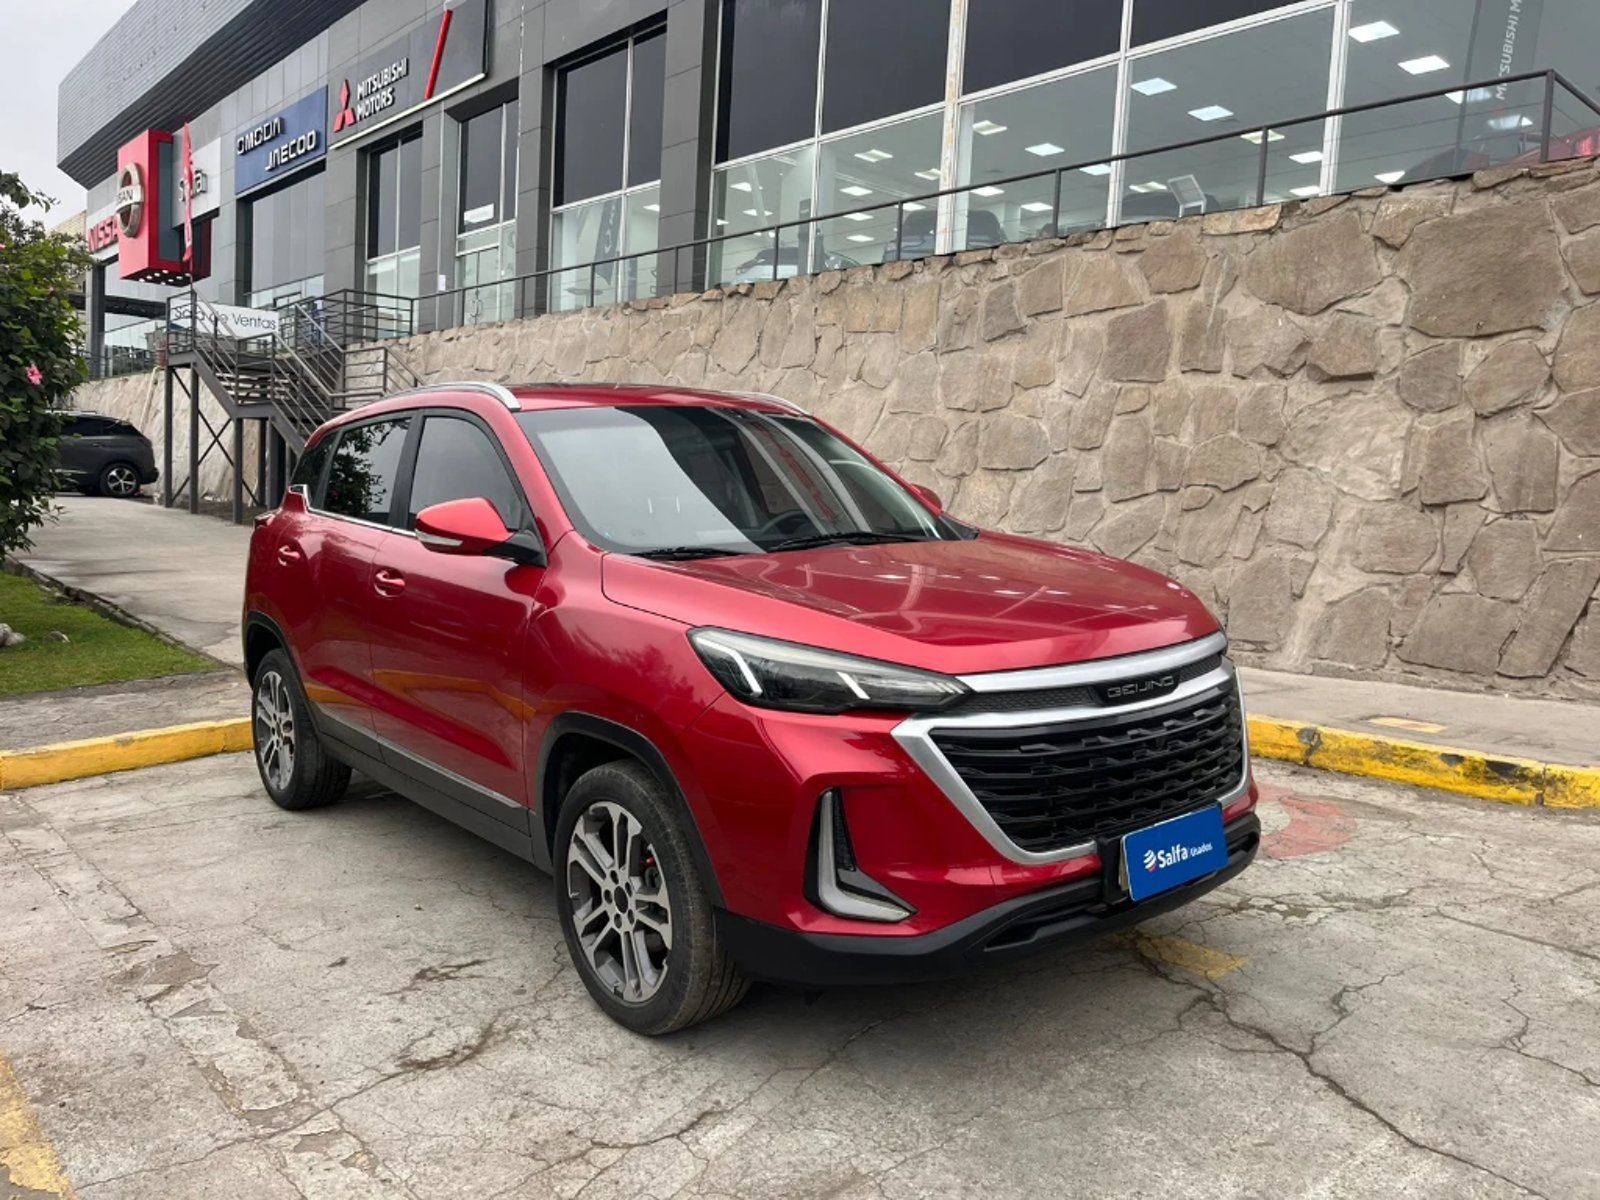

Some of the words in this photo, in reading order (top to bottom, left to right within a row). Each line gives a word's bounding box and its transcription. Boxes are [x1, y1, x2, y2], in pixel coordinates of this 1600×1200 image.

[1495, 14, 1519, 101] MSUBISHI
[357, 57, 409, 98] MITSUBISHI
[356, 87, 395, 122] MOTORS
[236, 117, 282, 155] OMODA
[264, 129, 317, 171] JAECOO
[174, 304, 206, 321] Saa
[232, 312, 277, 330] Ventas
[1157, 843, 1189, 869] Salfa
[1190, 842, 1214, 857] Usados
